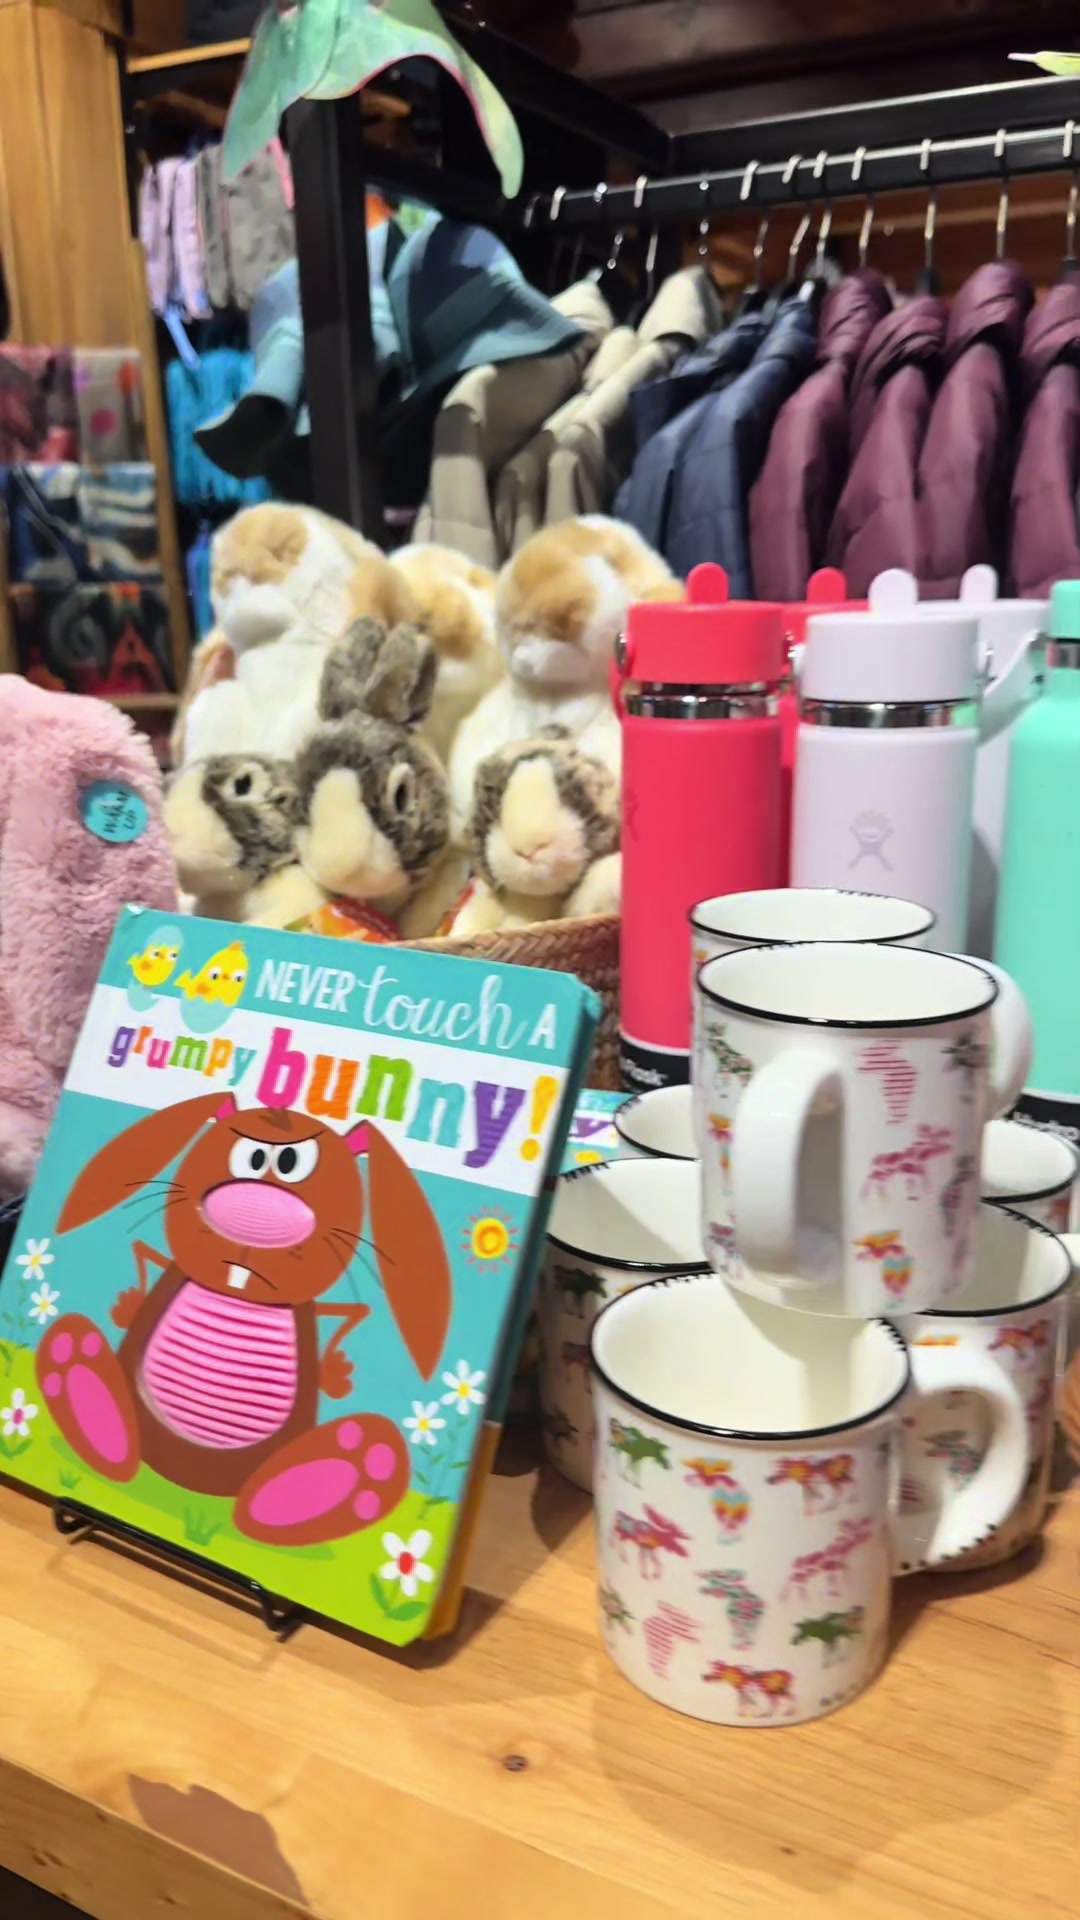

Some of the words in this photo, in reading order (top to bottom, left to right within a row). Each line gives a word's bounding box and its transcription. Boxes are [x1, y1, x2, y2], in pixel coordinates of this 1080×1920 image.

[255, 958, 356, 1013] NEVER
[357, 964, 528, 1050] touch
[528, 1003, 558, 1049] A
[107, 1025, 257, 1087] grumpy
[256, 1026, 560, 1169] bunny!
